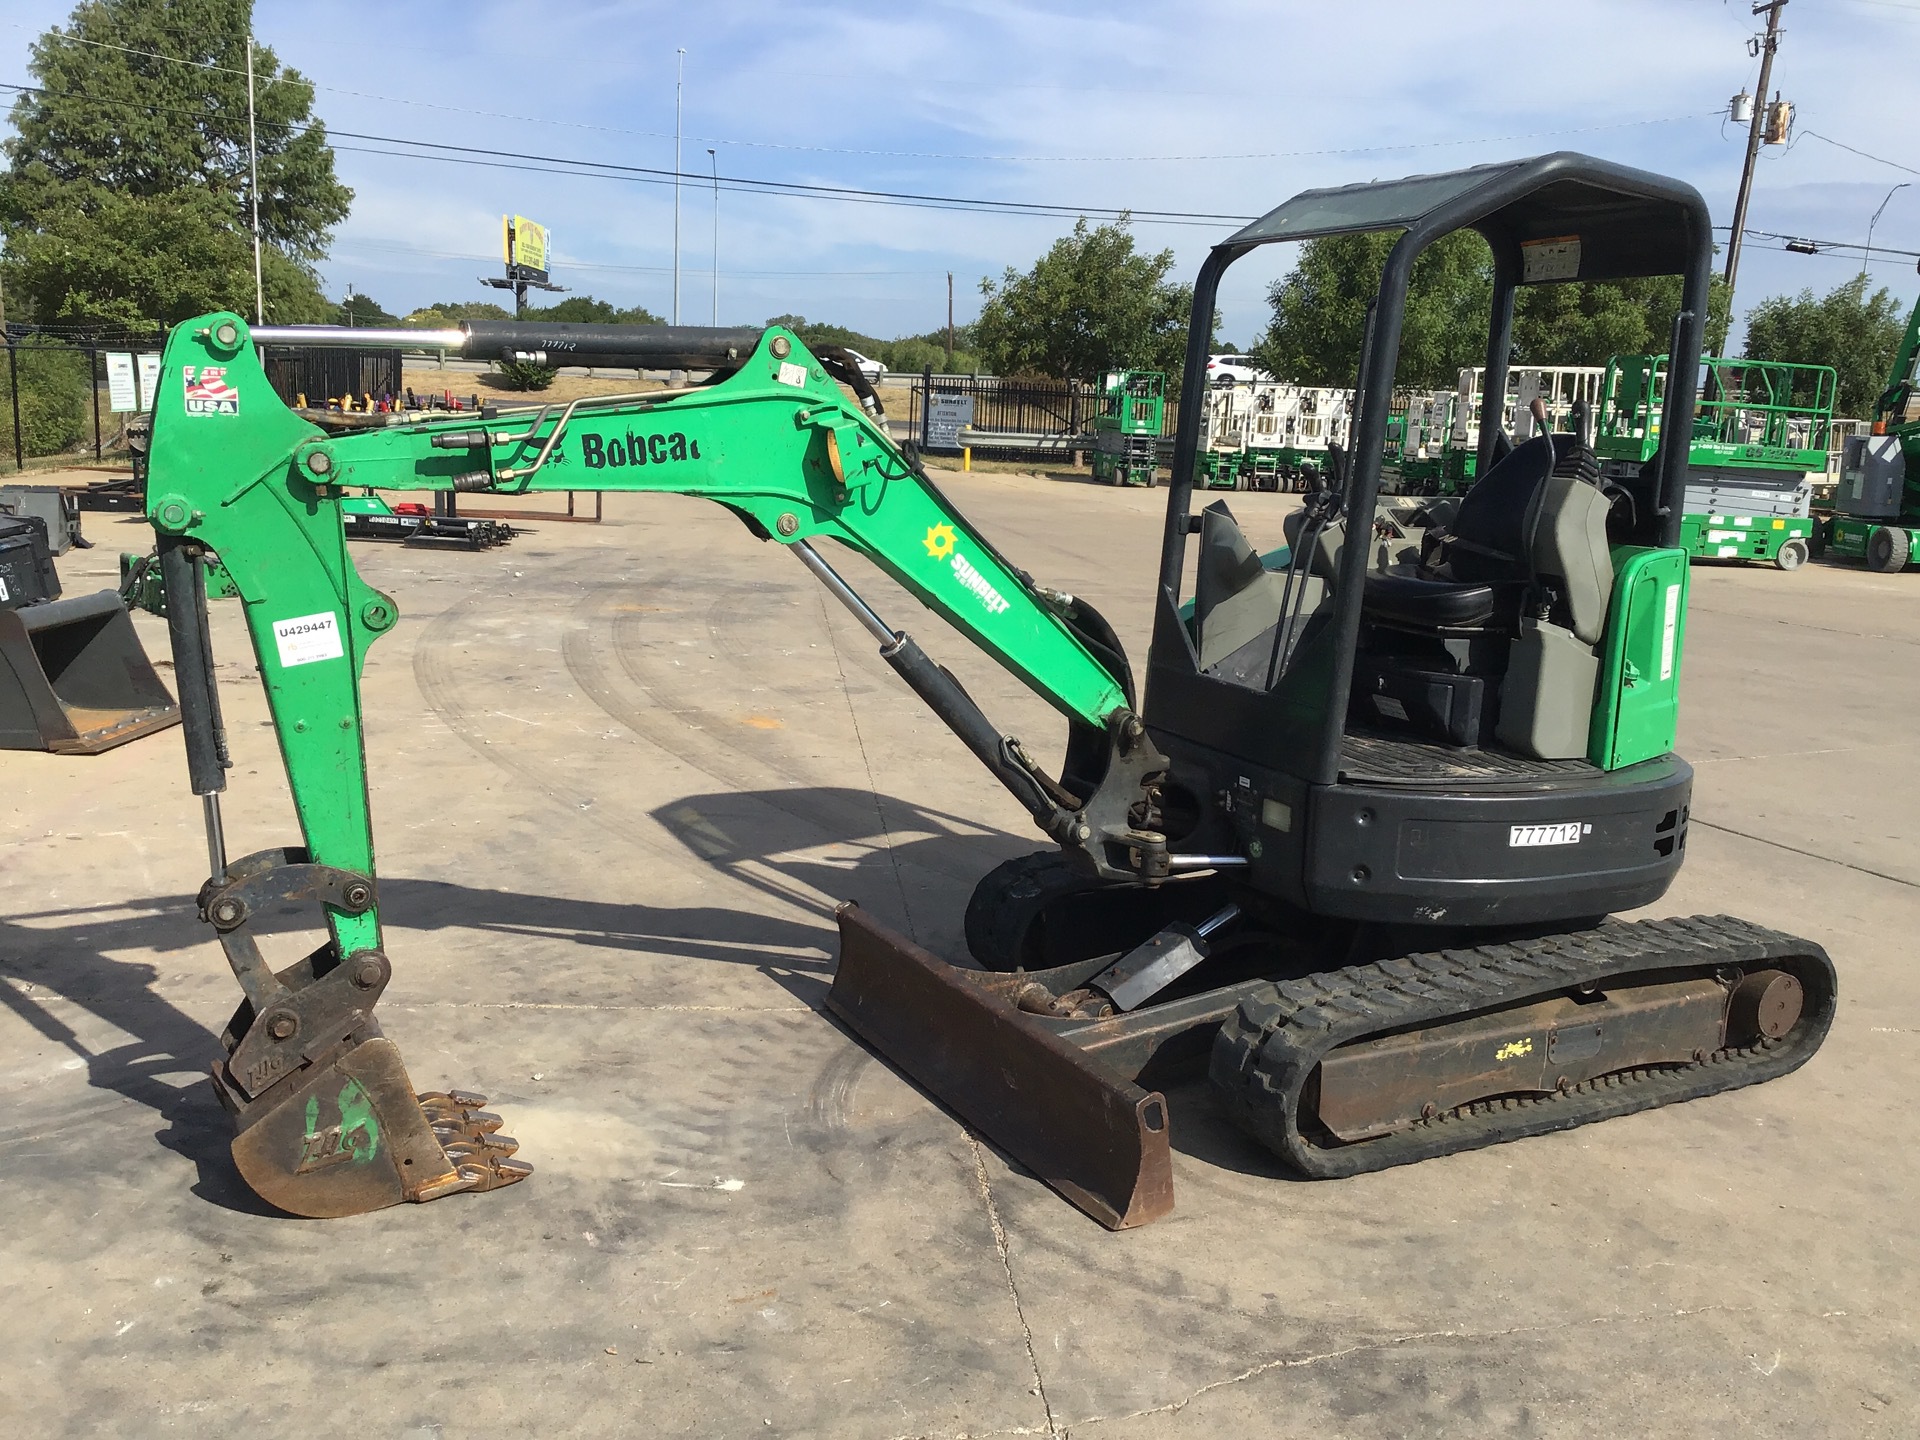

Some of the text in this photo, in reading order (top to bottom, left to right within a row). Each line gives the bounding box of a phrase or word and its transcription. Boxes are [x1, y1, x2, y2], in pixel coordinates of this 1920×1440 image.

[188, 400, 236, 413] USA
[950, 553, 1010, 615] SUNBELT
[279, 620, 332, 637] U429447
[1513, 824, 1579, 844] 777712
